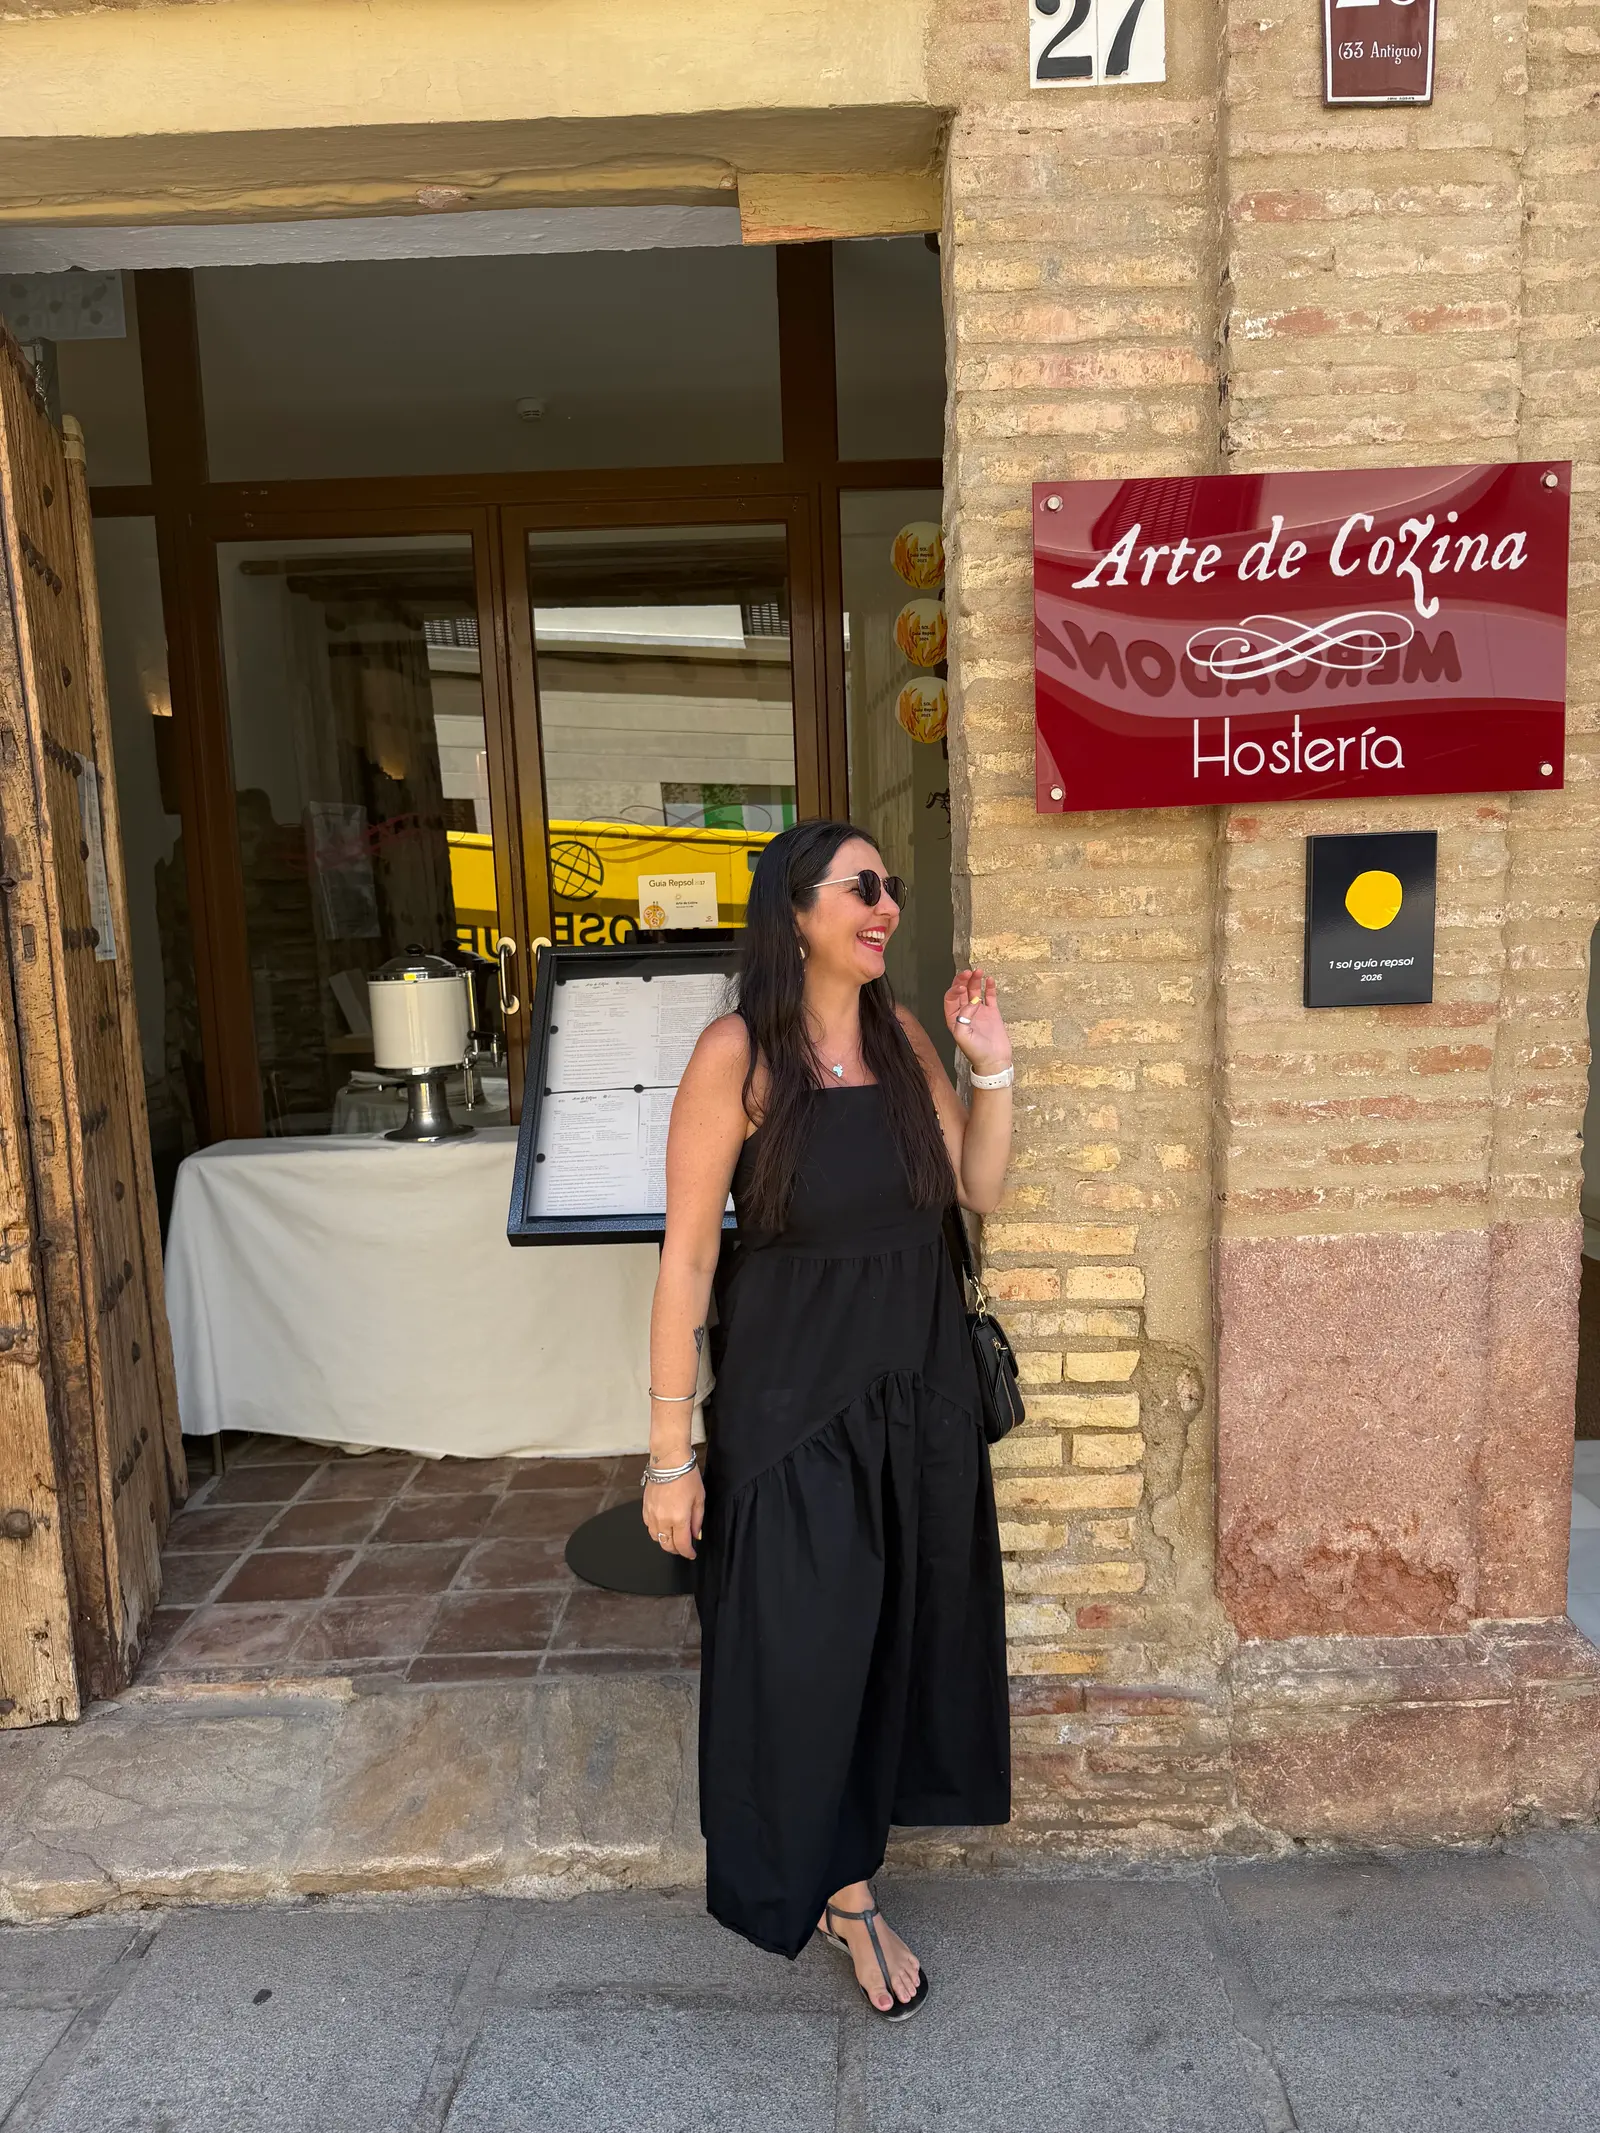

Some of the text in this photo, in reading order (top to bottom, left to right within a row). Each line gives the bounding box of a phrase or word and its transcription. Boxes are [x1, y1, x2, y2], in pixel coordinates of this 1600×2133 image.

[1035, 0, 1145, 79] 27
[1338, 41, 1422, 65] (33 Antiguo)
[1071, 523, 1222, 589] Arte
[1238, 515, 1307, 581] de
[1193, 714, 1405, 778] Hostería
[668, 878, 694, 888] Repsol
[1329, 957, 1415, 970] 1 sol guía repsol
[1360, 974, 1382, 982] 2026
